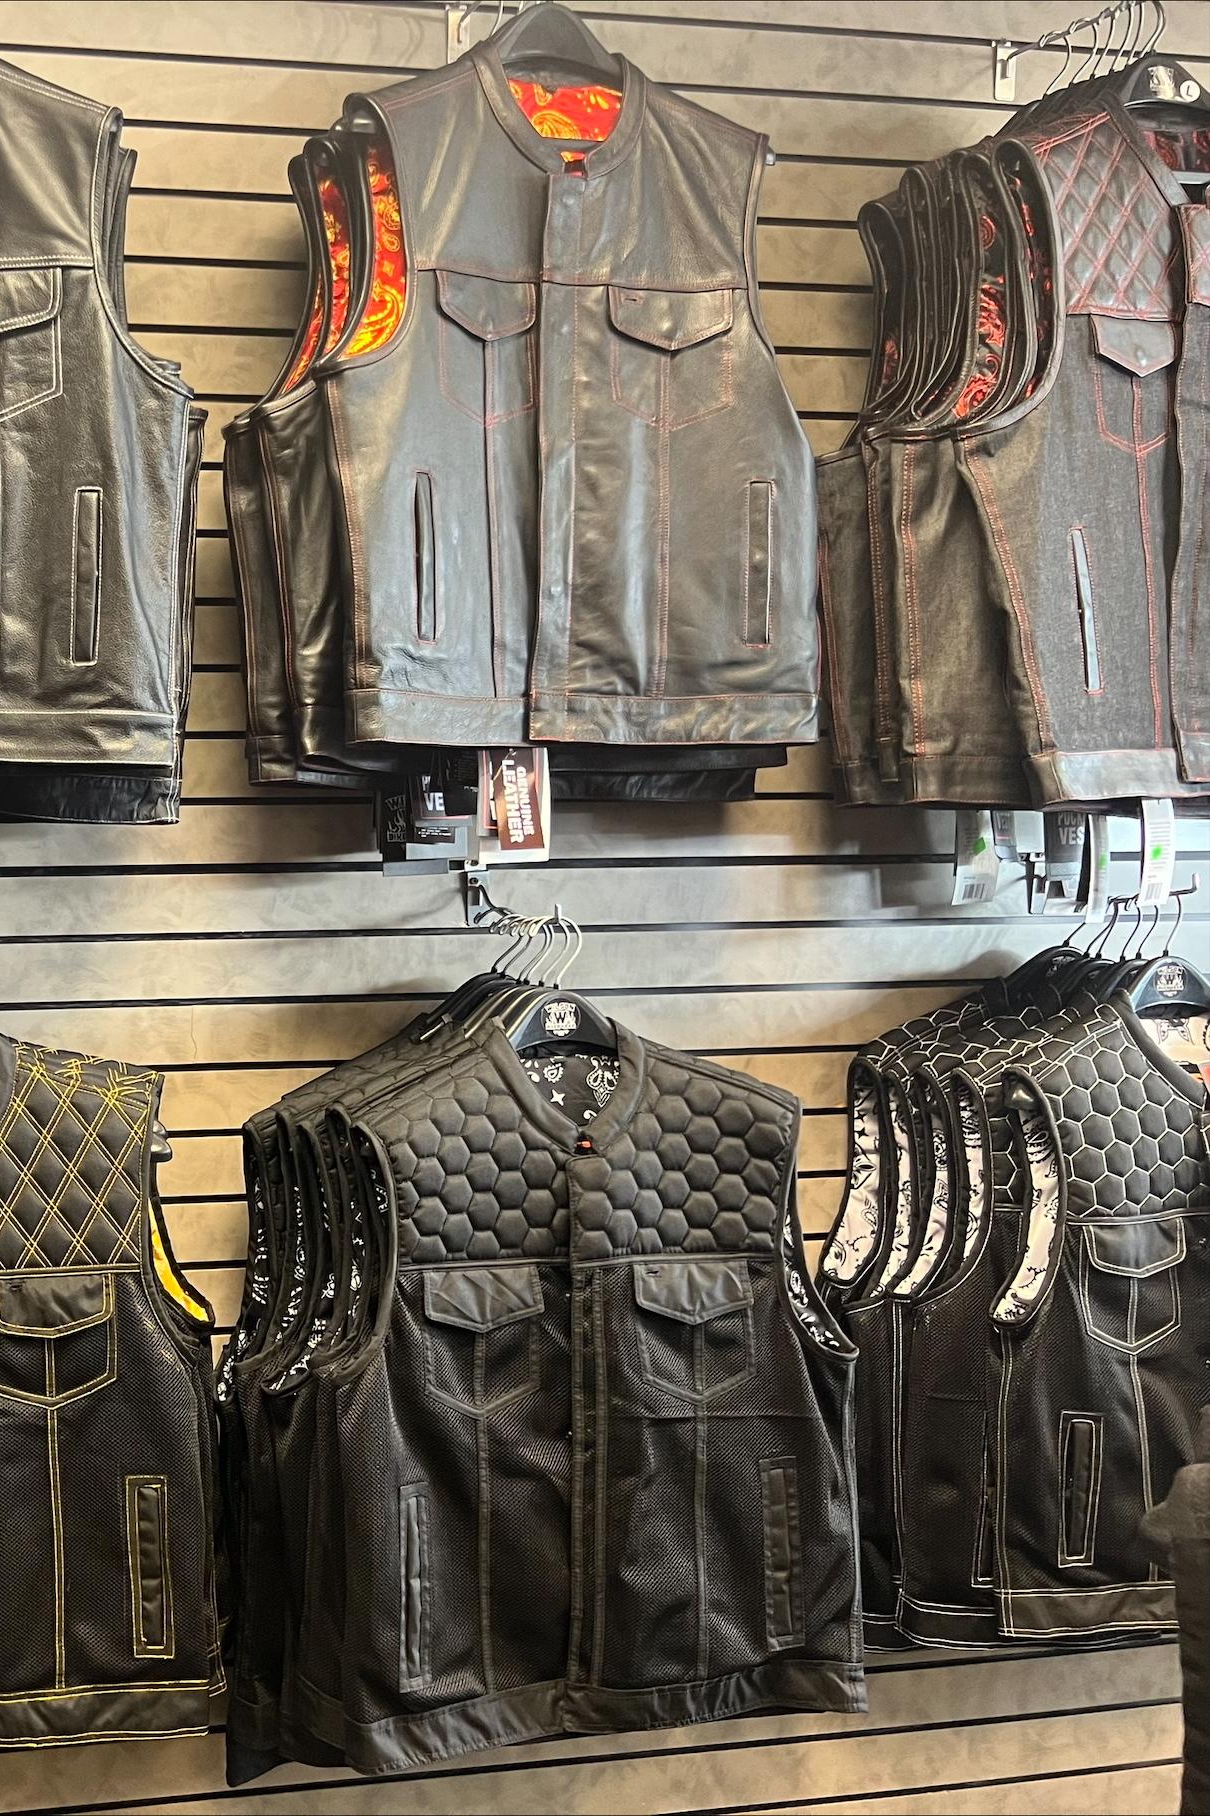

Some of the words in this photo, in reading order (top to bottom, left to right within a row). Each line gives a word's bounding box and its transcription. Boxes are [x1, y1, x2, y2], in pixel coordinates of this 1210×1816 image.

[1186, 85, 1193, 97] L
[424, 792, 445, 812] VE
[501, 760, 525, 845] LEATHER
[516, 766, 535, 836] GENUINE
[1058, 826, 1085, 845] VES
[555, 1011, 567, 1024] W
